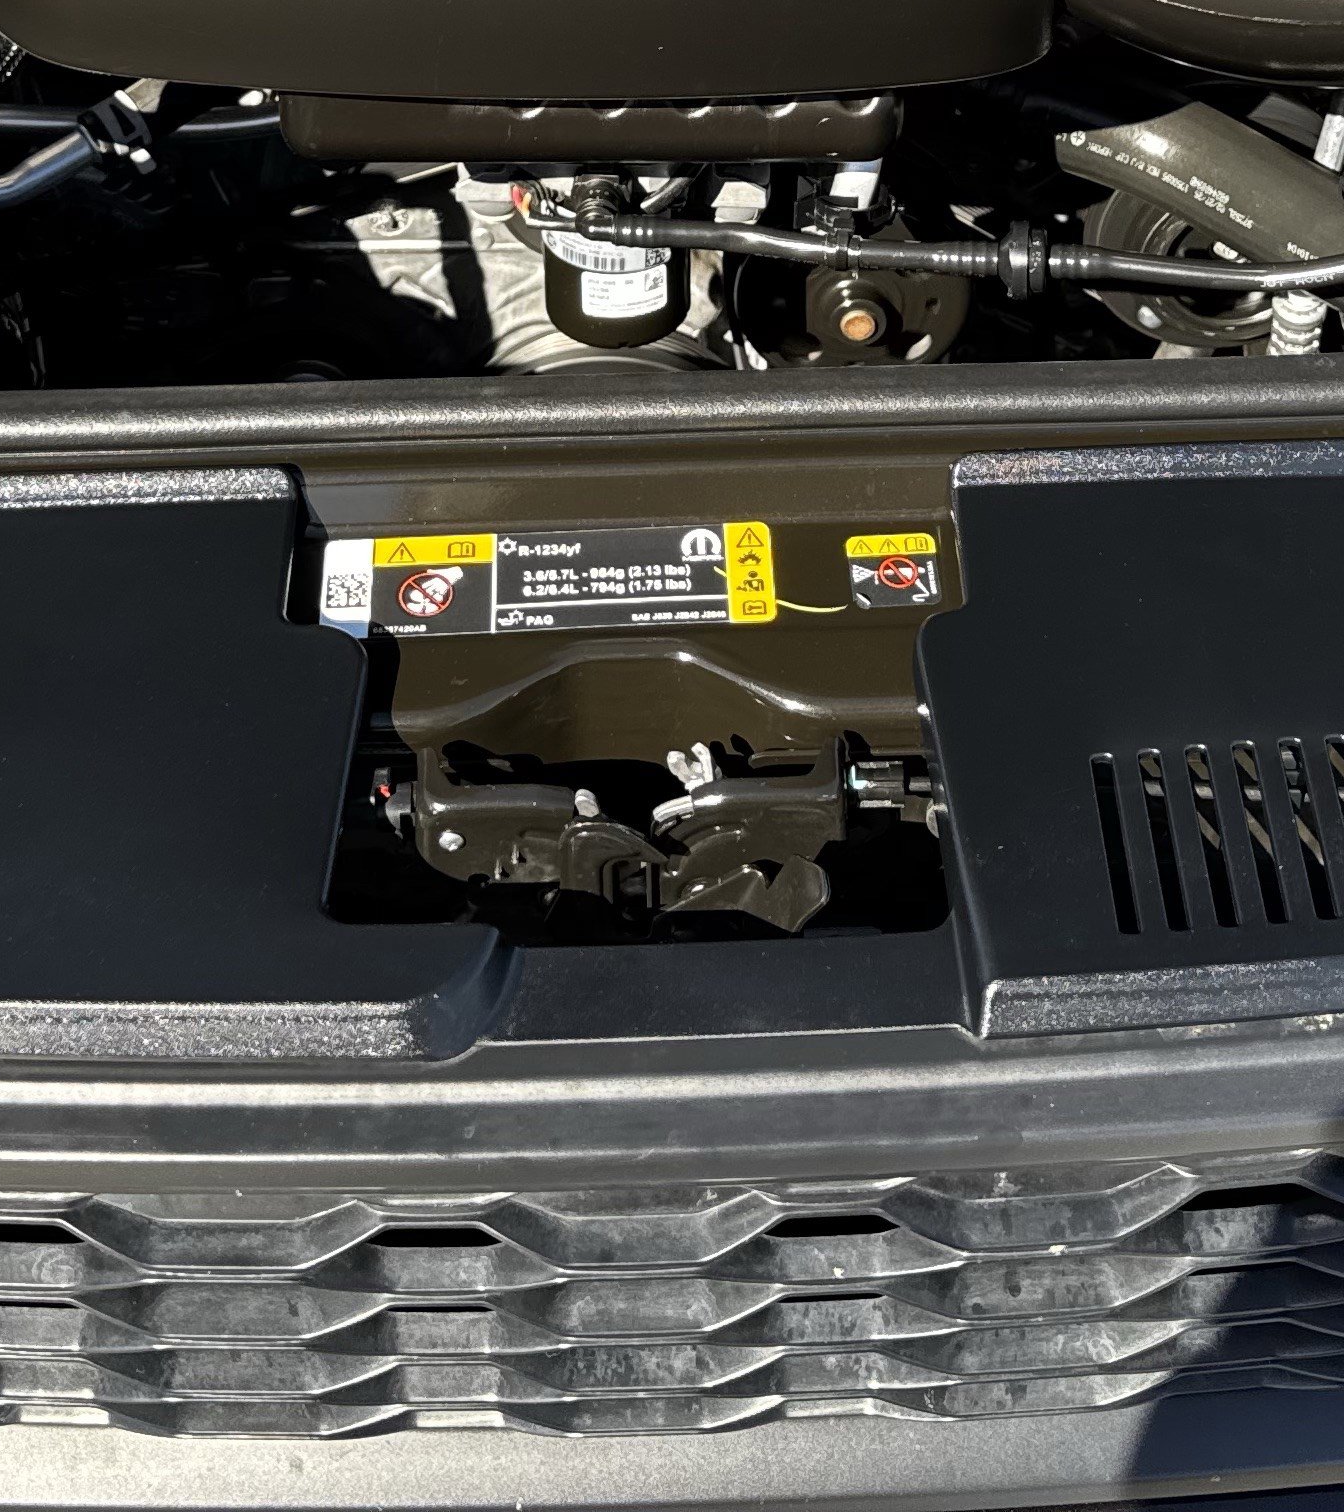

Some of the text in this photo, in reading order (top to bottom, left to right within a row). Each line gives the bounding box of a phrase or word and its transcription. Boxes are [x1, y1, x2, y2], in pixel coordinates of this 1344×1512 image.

[518, 542, 582, 557] R-1234yf
[628, 564, 662, 579] (2.13
[664, 563, 692, 578] lbs)
[665, 578, 693, 592] lbs)
